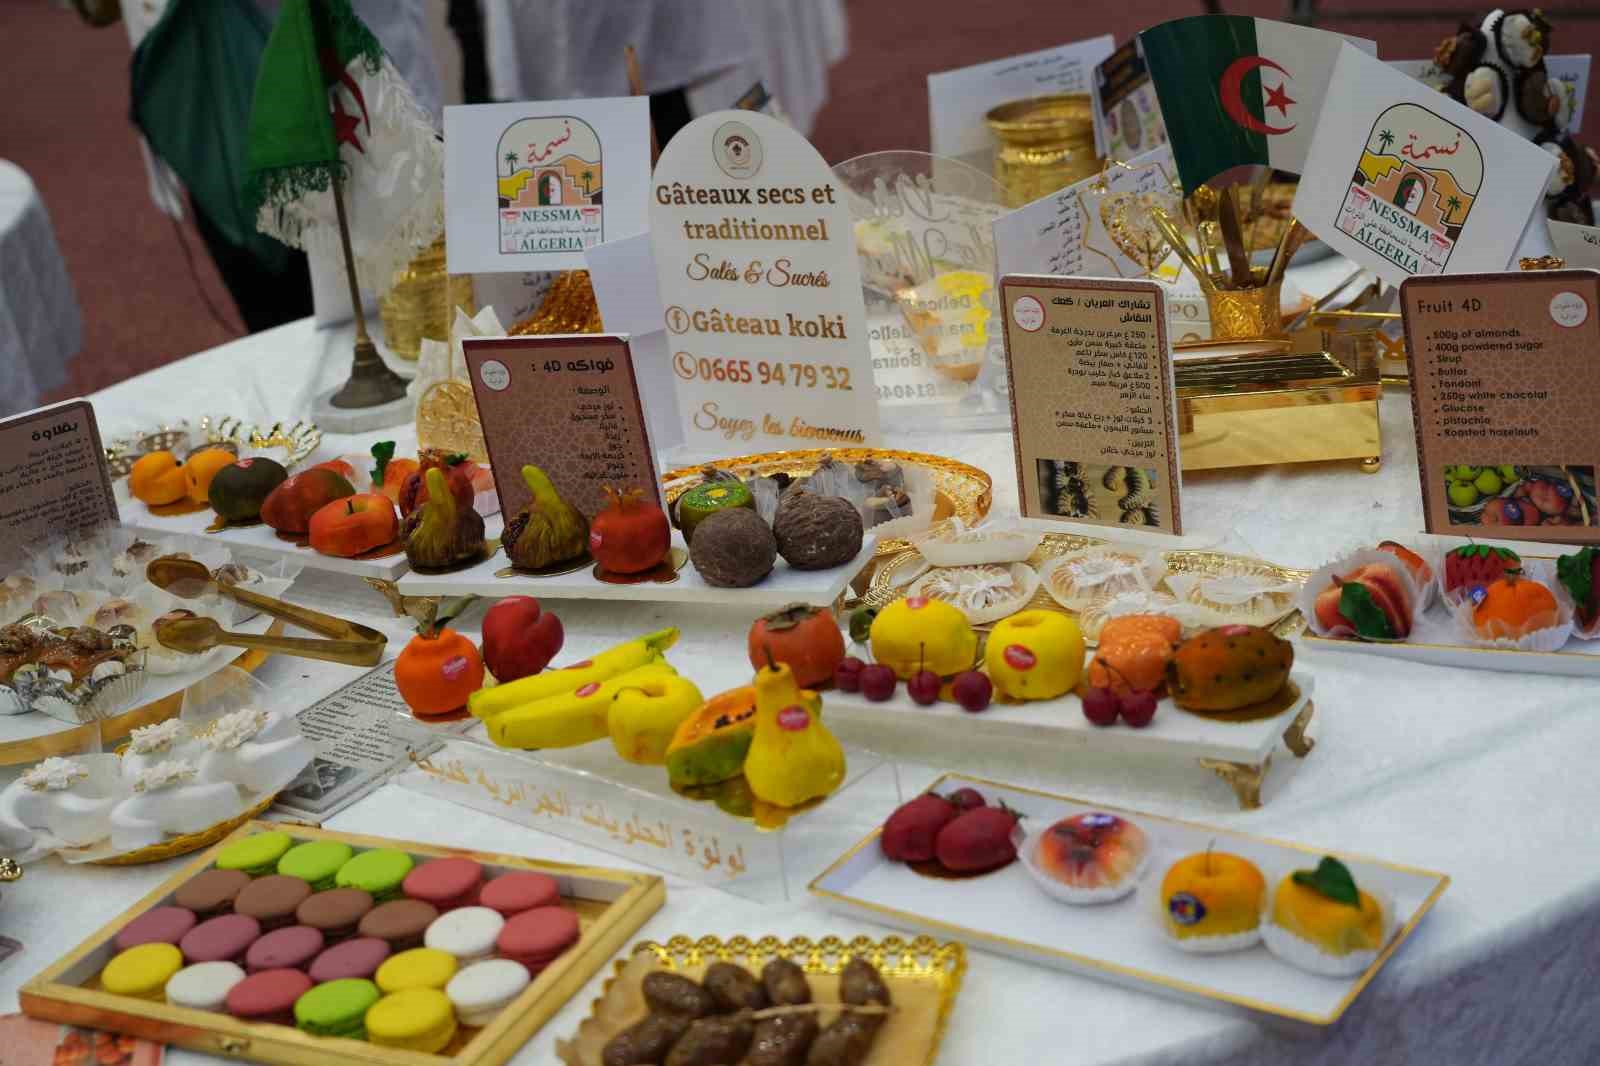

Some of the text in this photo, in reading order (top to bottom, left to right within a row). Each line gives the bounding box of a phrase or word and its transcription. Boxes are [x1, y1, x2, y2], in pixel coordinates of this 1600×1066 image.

[527, 119, 573, 164] نسمة
[1401, 131, 1462, 160] نسمة
[656, 182, 836, 205] Gâteaux secs et
[522, 208, 582, 223] NESSMA
[1369, 198, 1431, 244] NESSMA
[683, 218, 830, 241] traditionnel
[520, 236, 584, 251] ALGERIA
[1356, 227, 1420, 274] ALGERIA
[686, 253, 831, 288] Salés & Sucrés
[1084, 297, 1115, 309] العريان
[1417, 298, 1482, 313] Fruit 4D
[692, 307, 848, 340] Gâteau koki
[1119, 312, 1152, 323] النقاش
[1475, 328, 1521, 338] almonds
[543, 359, 561, 373] 4D
[567, 357, 614, 374] فواكه
[700, 357, 853, 391] 0665 94 79 32
[31, 421, 79, 441] بقلاوة
[693, 402, 755, 440] Soyez
[762, 413, 786, 437] les
[1489, 426, 1539, 437] hazelnuts
